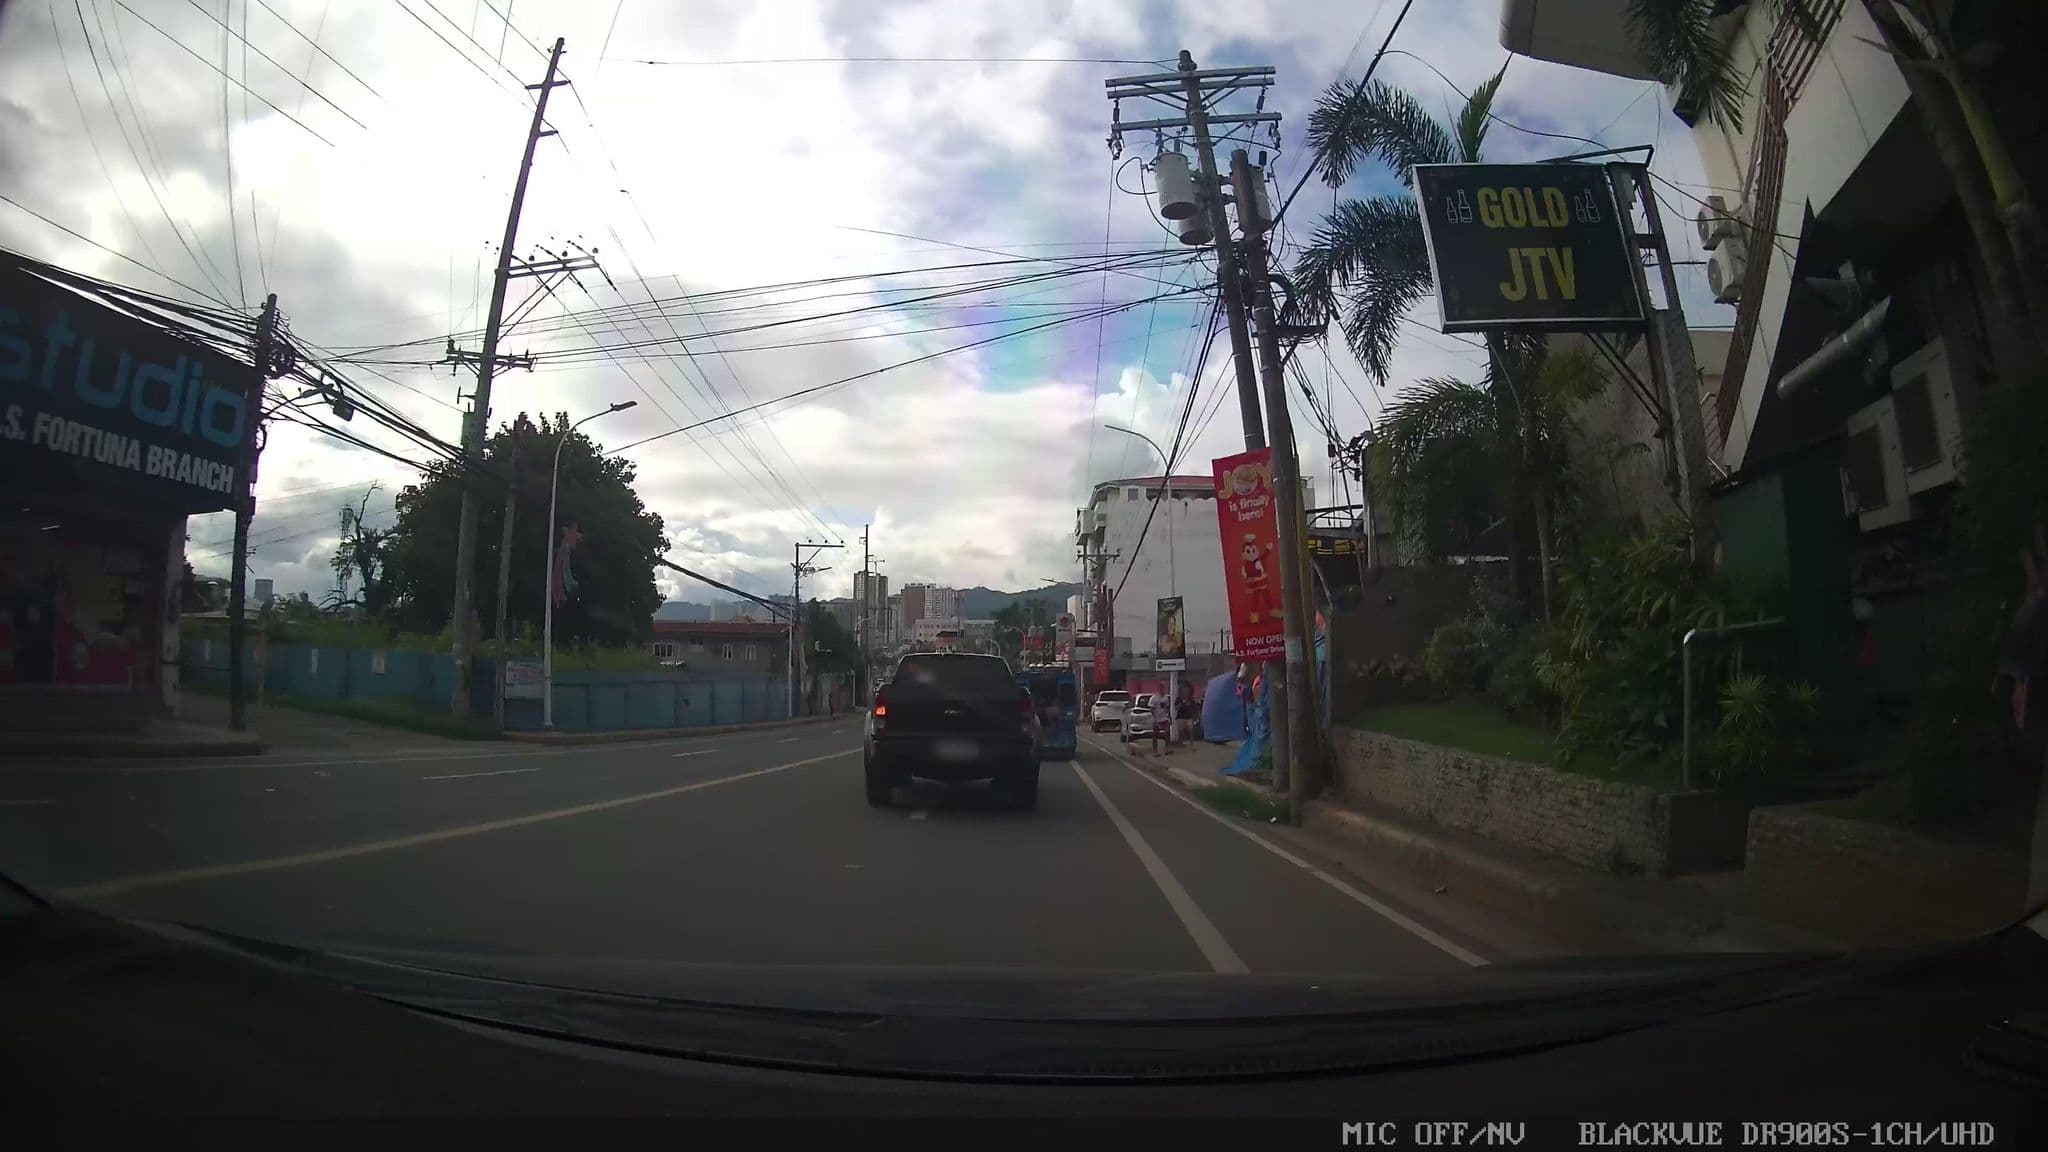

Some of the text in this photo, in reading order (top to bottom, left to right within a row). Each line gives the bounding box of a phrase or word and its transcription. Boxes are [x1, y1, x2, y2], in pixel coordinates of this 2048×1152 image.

[1477, 186, 1570, 229] GOLD
[1499, 247, 1576, 301] JTV
[0, 307, 246, 448] studio
[32, 411, 141, 472] FORTUNA
[146, 445, 234, 494] BRANCH
[1239, 495, 1270, 510] finally
[1246, 636, 1265, 646] NOW
